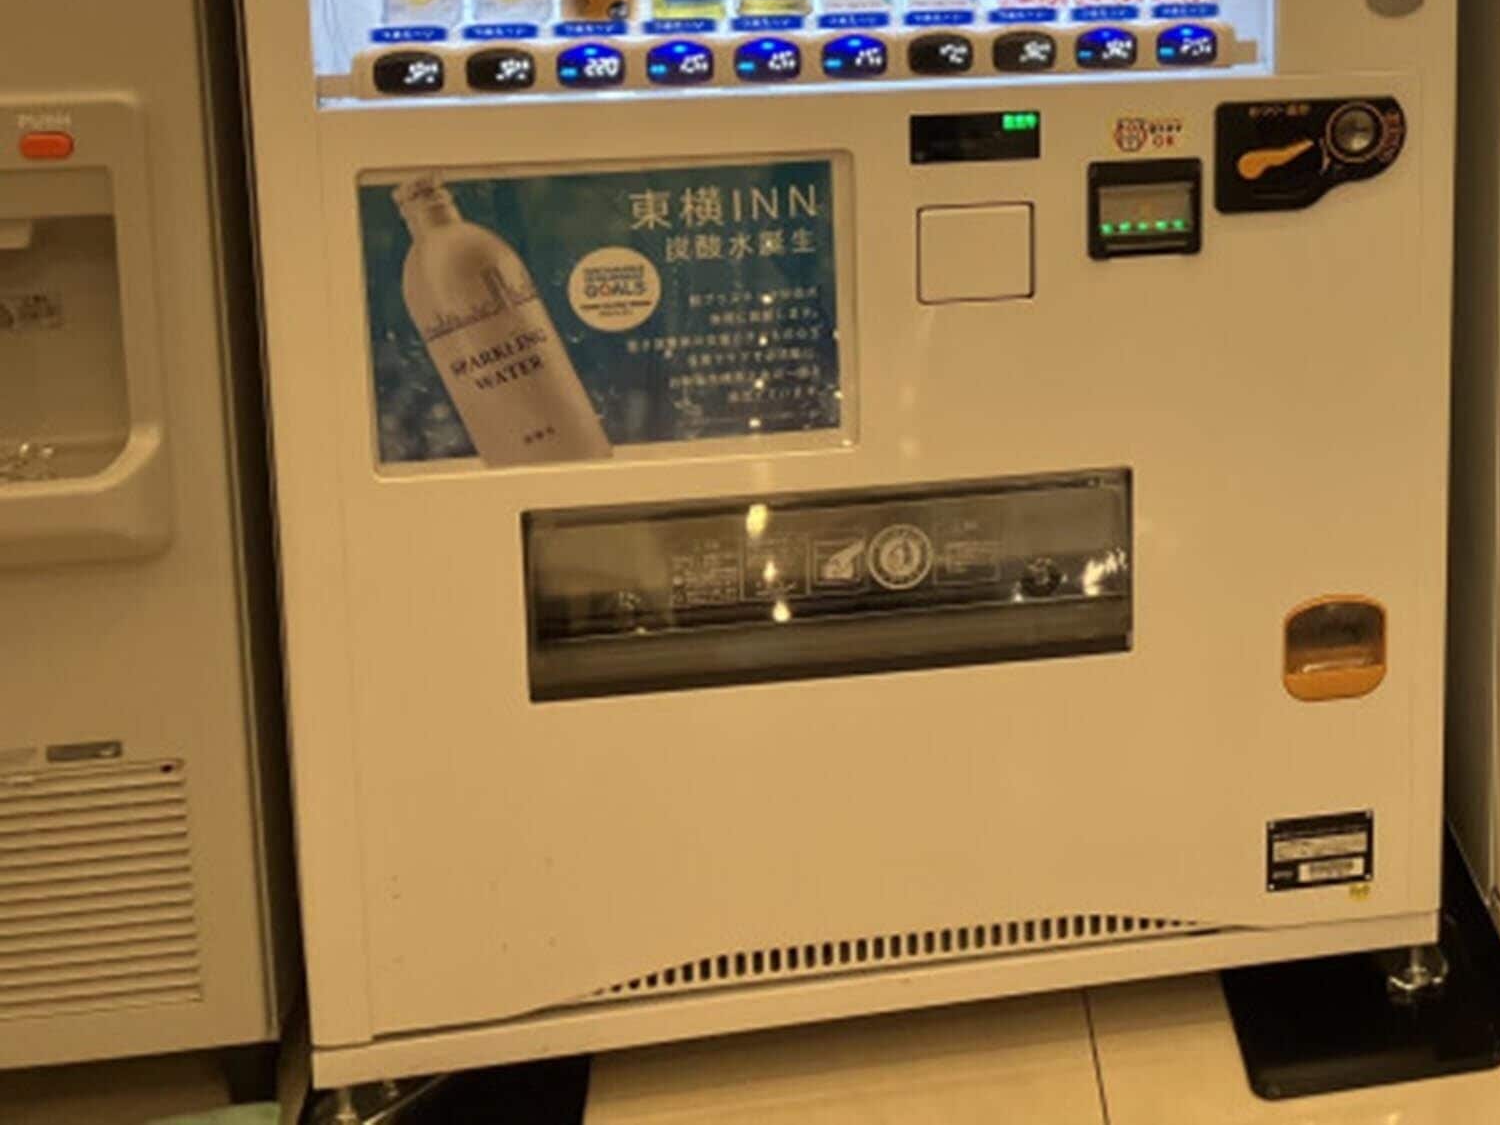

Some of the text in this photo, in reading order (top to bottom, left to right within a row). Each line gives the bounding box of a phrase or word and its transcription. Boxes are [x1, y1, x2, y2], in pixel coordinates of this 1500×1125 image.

[628, 183, 819, 229] 東横INN
[451, 329, 547, 375] SPARKLING
[474, 354, 545, 391] WATER
